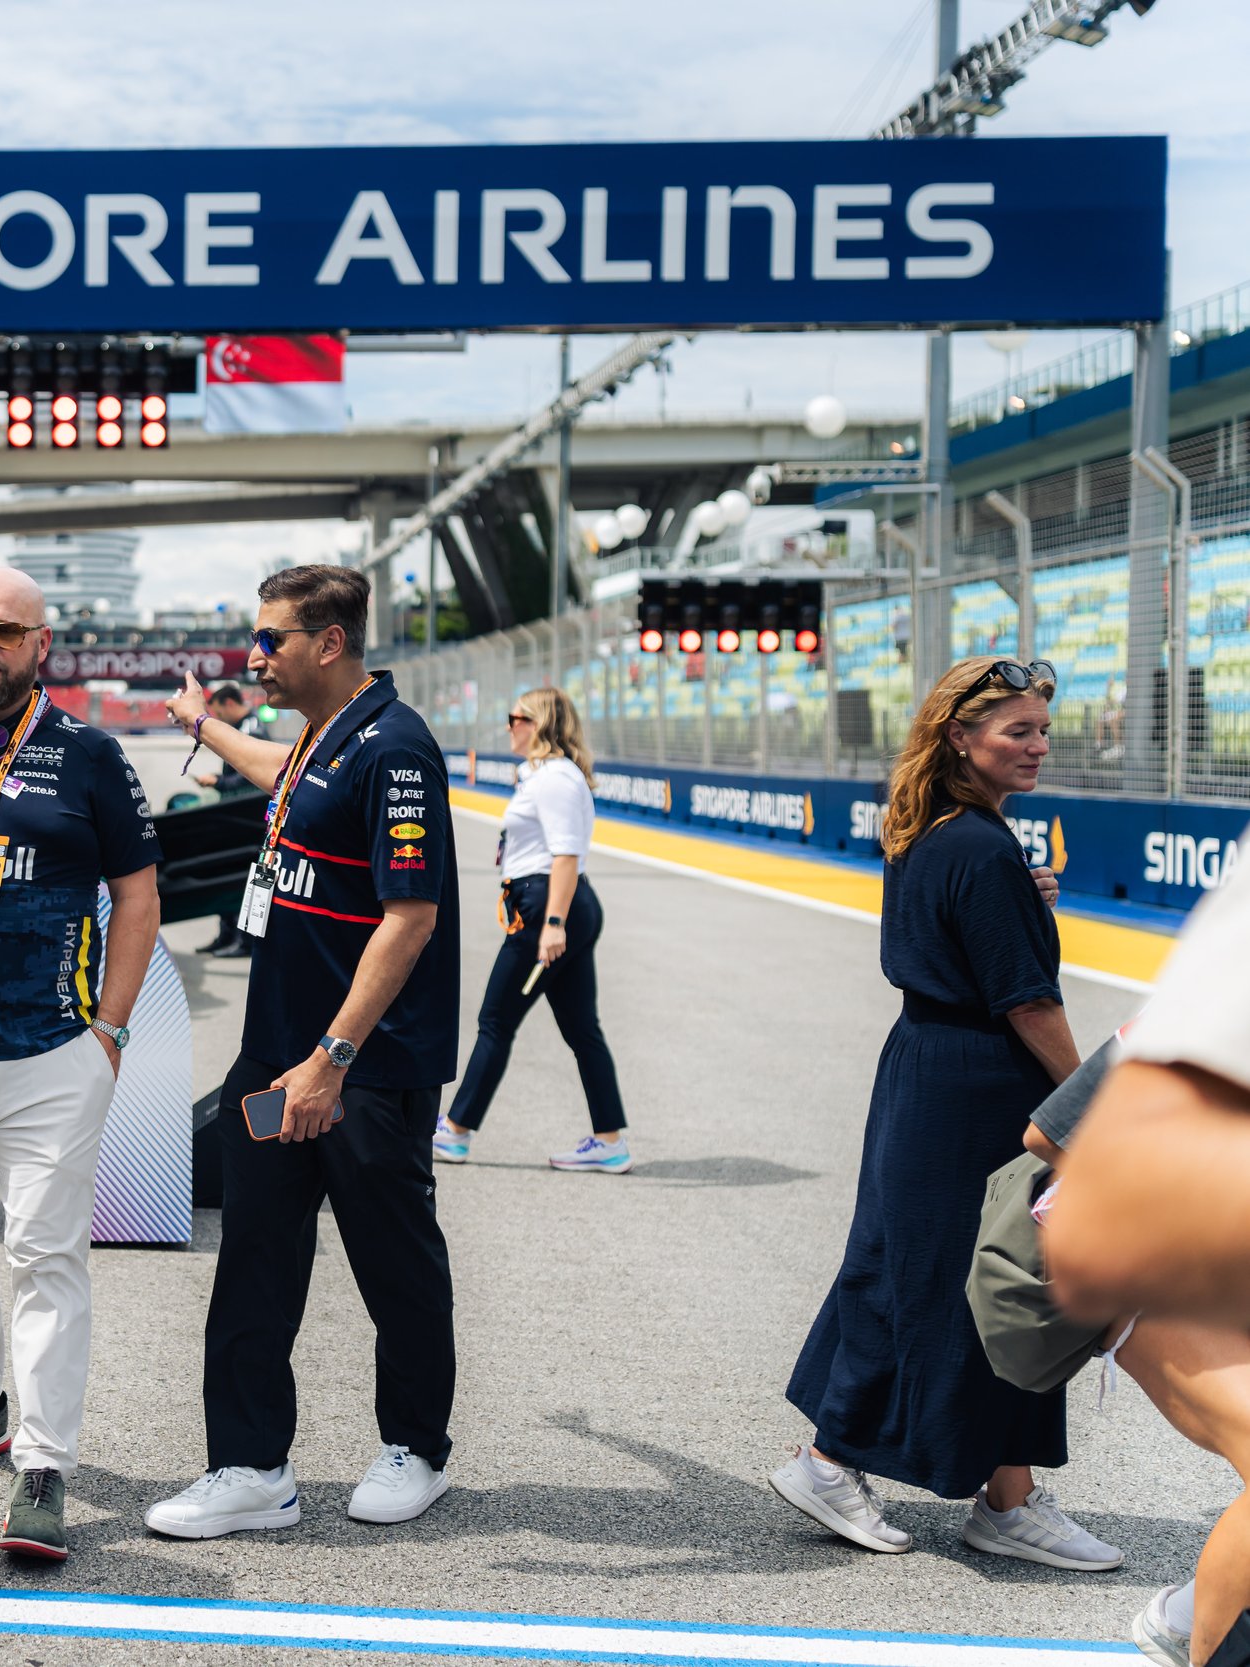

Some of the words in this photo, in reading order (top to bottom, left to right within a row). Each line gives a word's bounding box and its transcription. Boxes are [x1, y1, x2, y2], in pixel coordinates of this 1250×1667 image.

[314, 182, 996, 285] AIRLINES
[78, 651, 225, 678] singapore
[20, 745, 65, 755] ORACLE
[15, 759, 63, 767] RACING
[12, 770, 60, 781] HONDA
[305, 773, 328, 789] HONDA
[388, 769, 423, 783] VISA
[21, 784, 58, 796] Gate.io
[402, 789, 425, 800] AT&T
[387, 806, 425, 819] ROKT
[691, 784, 750, 821] SINGAPORE
[750, 790, 805, 831] AIRLINES
[390, 859, 410, 870] Red
[410, 859, 426, 870] Bull
